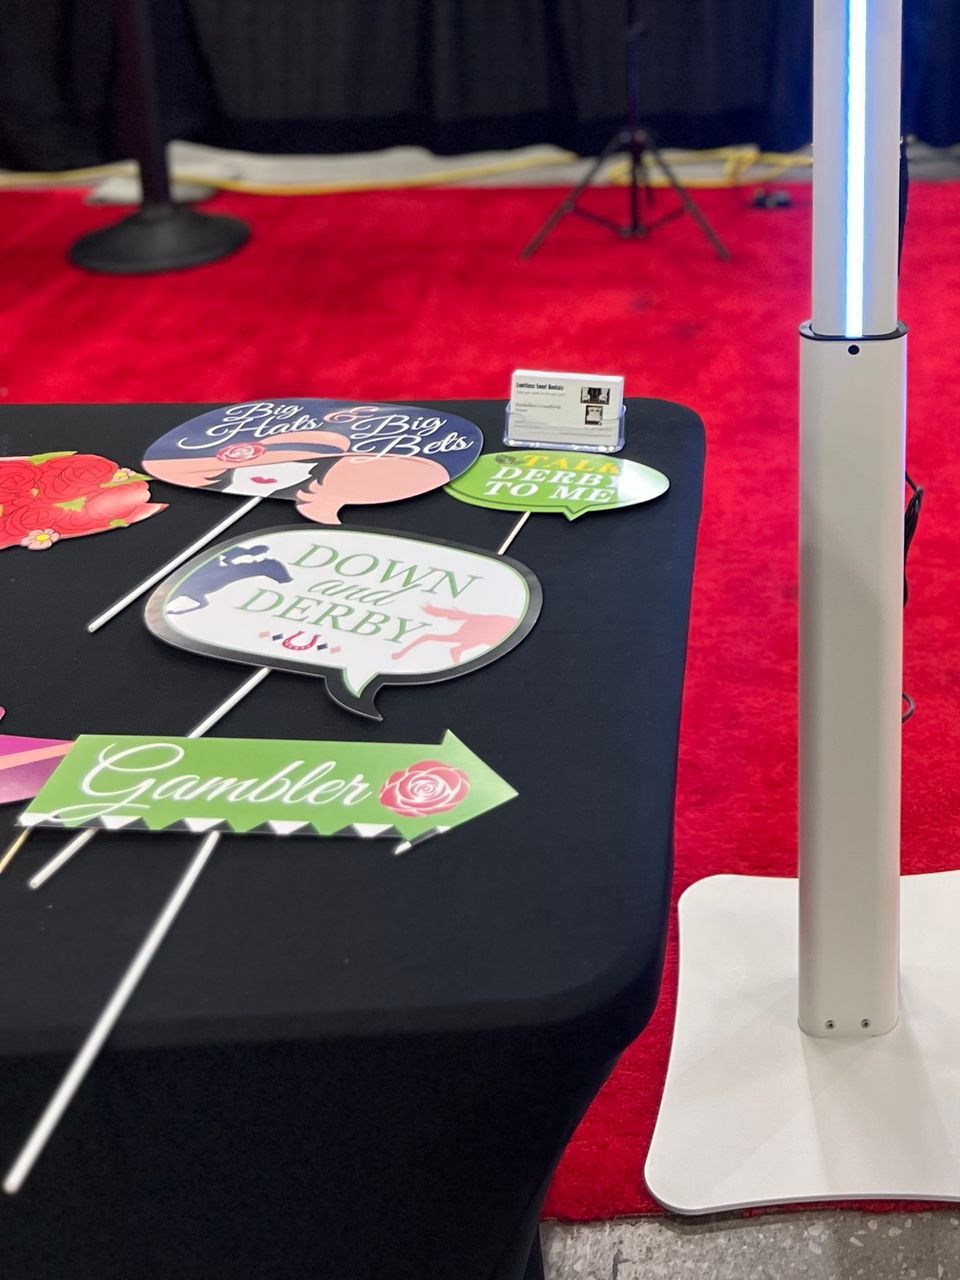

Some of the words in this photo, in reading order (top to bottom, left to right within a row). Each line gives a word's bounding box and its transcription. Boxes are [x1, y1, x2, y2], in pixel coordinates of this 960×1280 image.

[223, 402, 303, 422] Big
[350, 414, 447, 439] Big
[177, 415, 324, 450] Hats
[350, 432, 474, 463] Bets
[485, 480, 539, 497] TO
[550, 486, 617, 503] ME
[288, 543, 484, 599] DOWN
[307, 579, 423, 606] and
[233, 587, 433, 643] DERBY
[46, 742, 373, 822] Gambler
